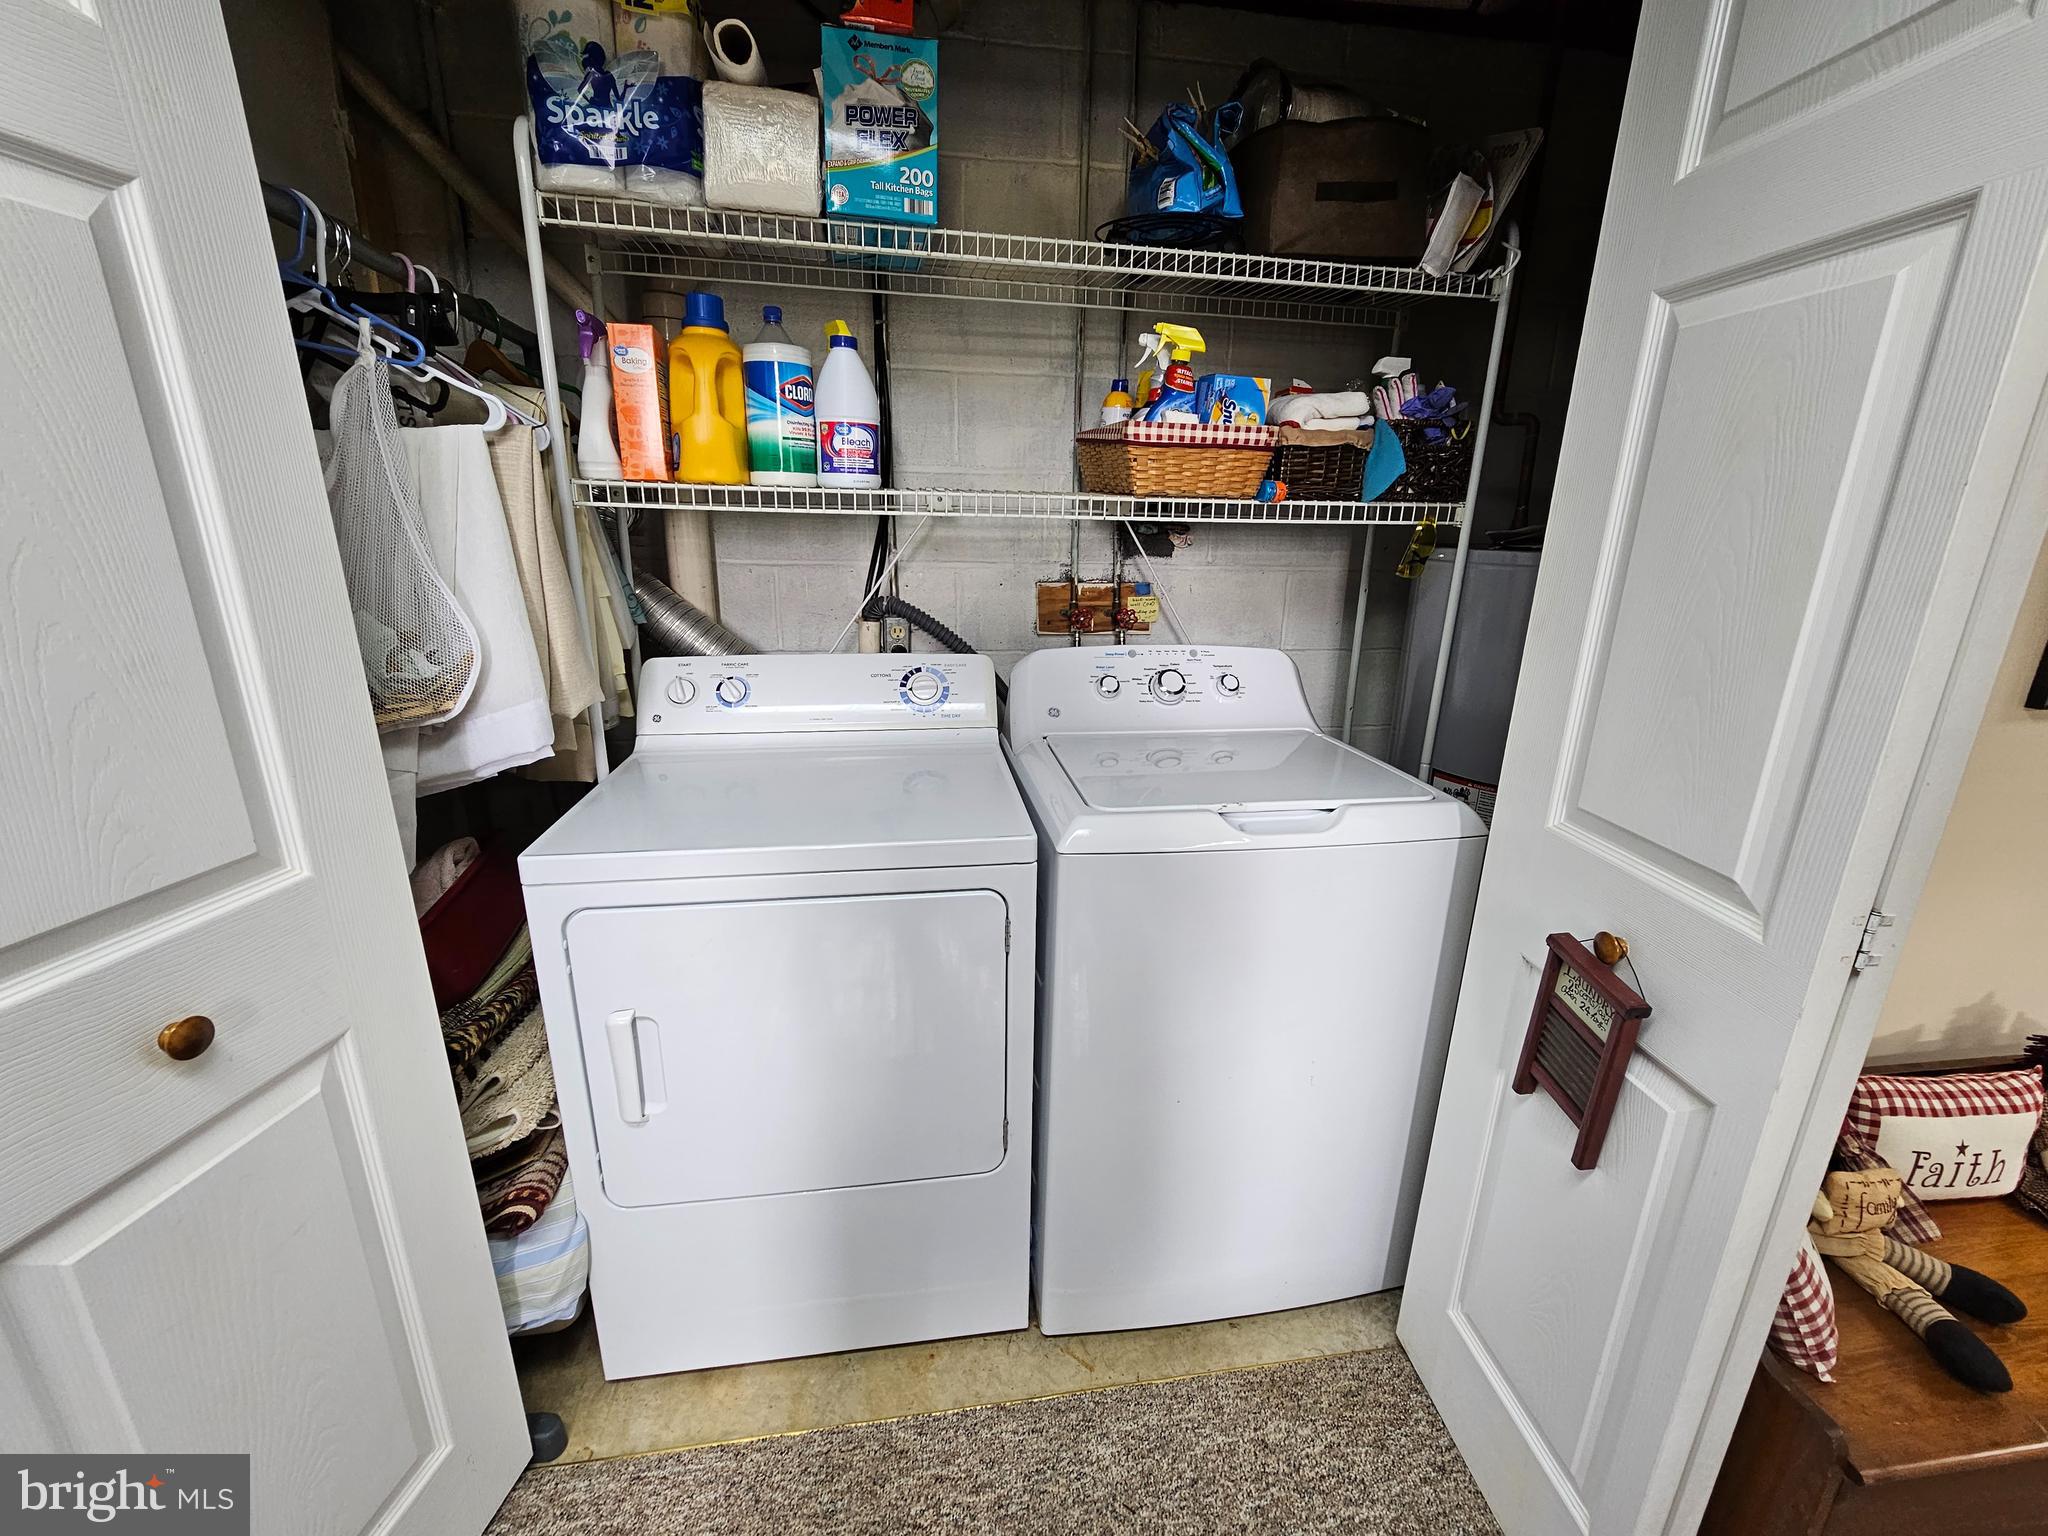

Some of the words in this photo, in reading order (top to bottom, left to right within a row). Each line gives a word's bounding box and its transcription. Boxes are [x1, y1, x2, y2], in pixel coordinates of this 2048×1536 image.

[546, 96, 660, 136] Sparkle
[845, 105, 919, 127] POWER
[856, 129, 909, 151] FLEX
[899, 166, 934, 188] 200
[870, 180, 884, 190] Tall
[885, 182, 914, 194] Kitchen
[915, 186, 934, 198] Bags
[621, 357, 648, 367] Baking
[841, 436, 871, 447] Bleach
[1563, 965, 1617, 1019] LAUNDRY
[1580, 1001, 1591, 1017] 24
[1906, 1148, 2007, 1188] Faith
[1855, 1191, 1897, 1230] family
